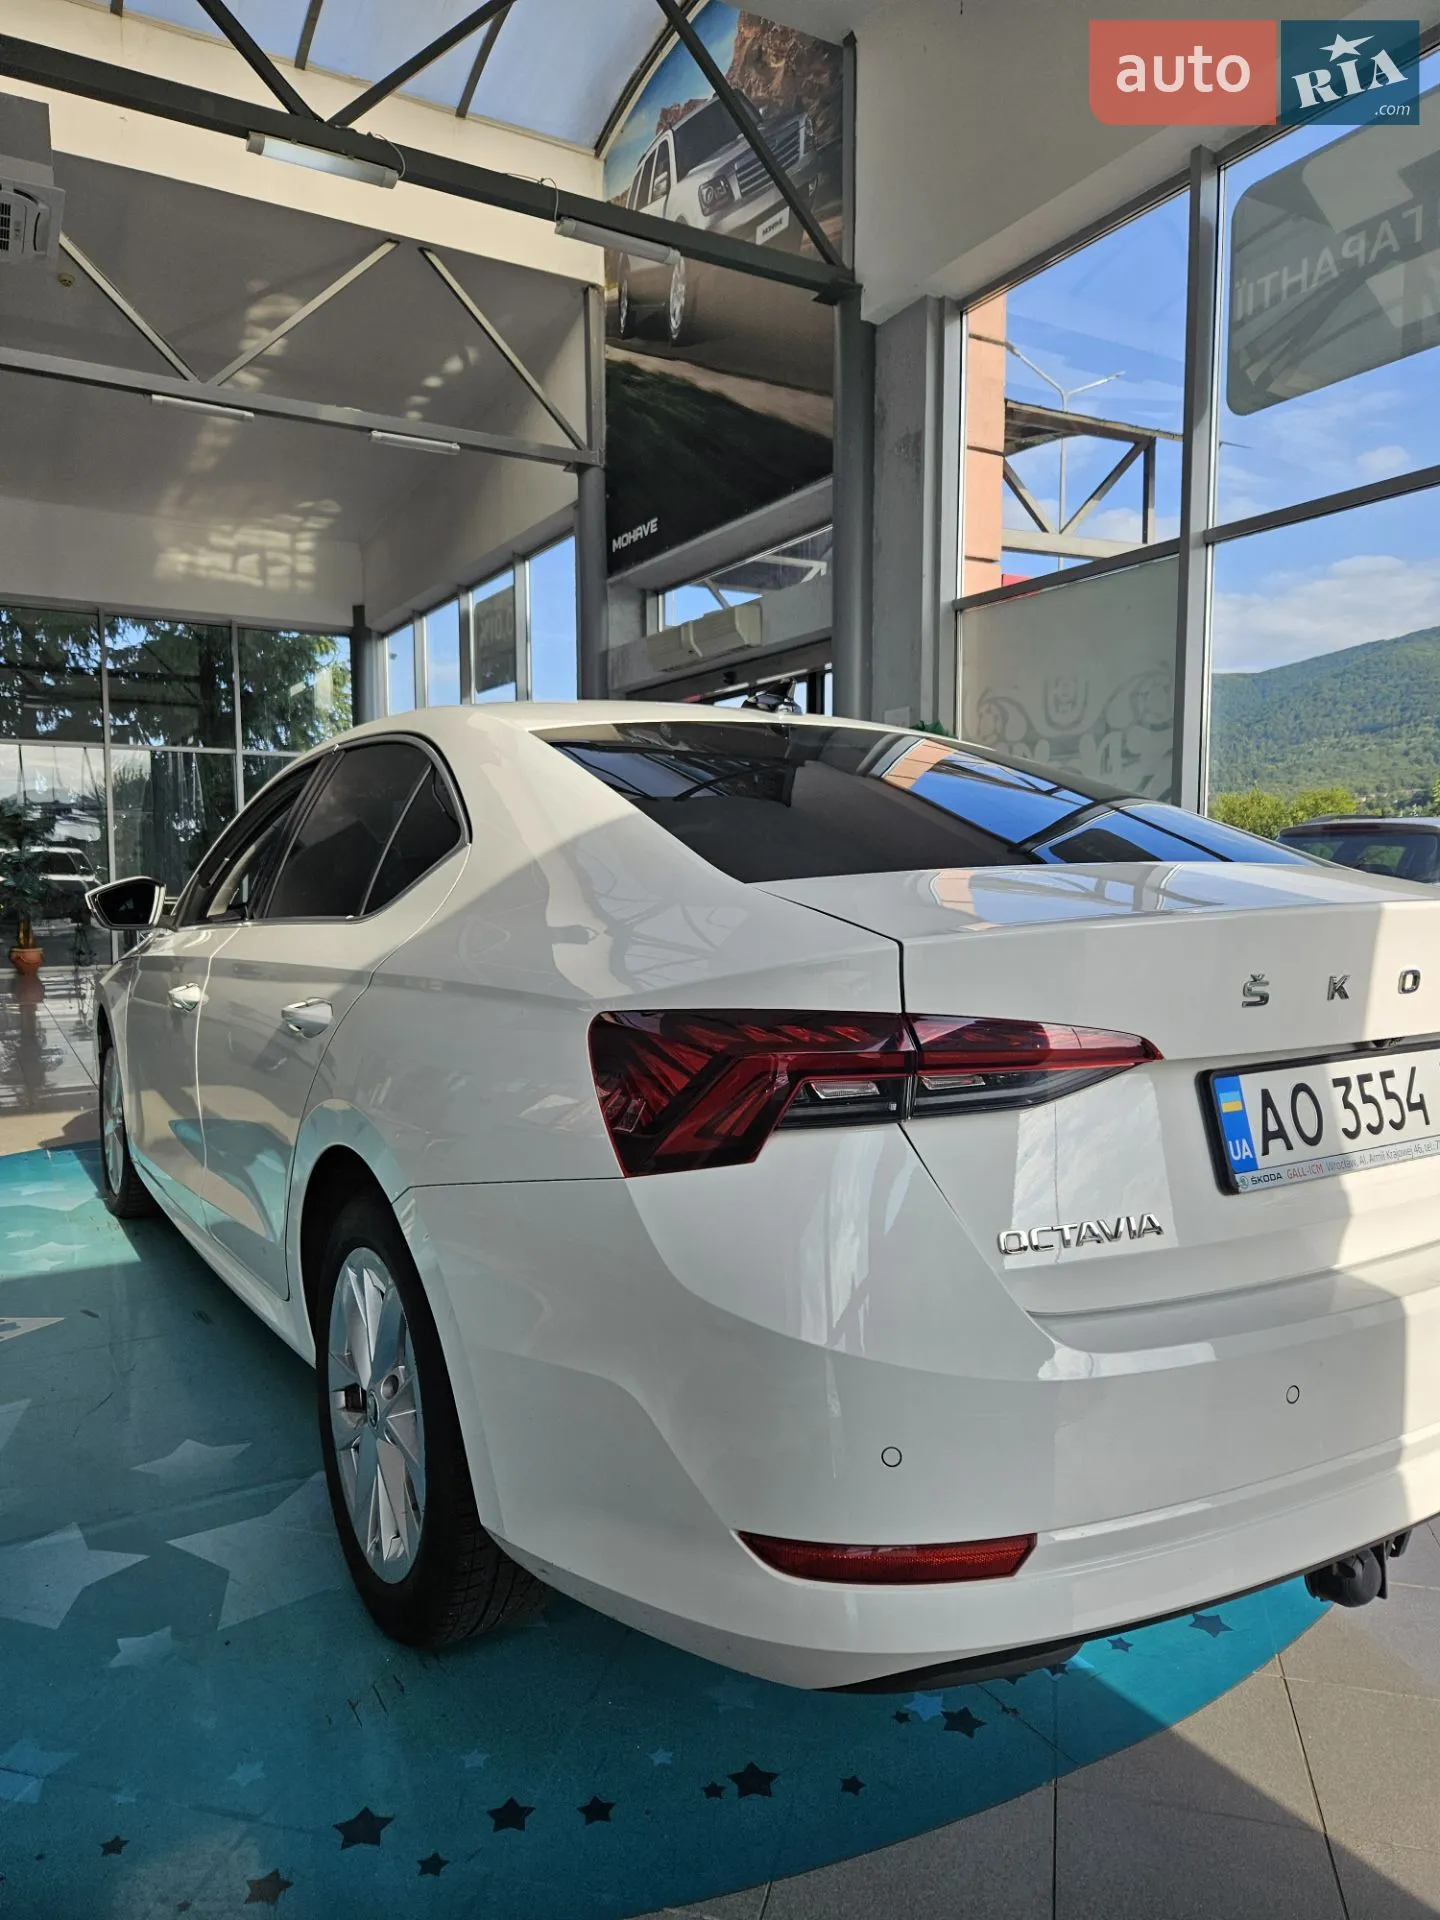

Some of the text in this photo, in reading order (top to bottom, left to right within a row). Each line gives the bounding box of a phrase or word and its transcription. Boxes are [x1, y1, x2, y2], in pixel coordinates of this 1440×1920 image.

[611, 516, 659, 553] MOHAVE
[1260, 1066, 1431, 1157] AO 3554
[1228, 1138, 1254, 1161] UA
[1250, 1172, 1283, 1185] ŠKODA
[1286, 1163, 1324, 1180] GALL-ICM
[996, 1211, 1164, 1256] OCTAVIA
